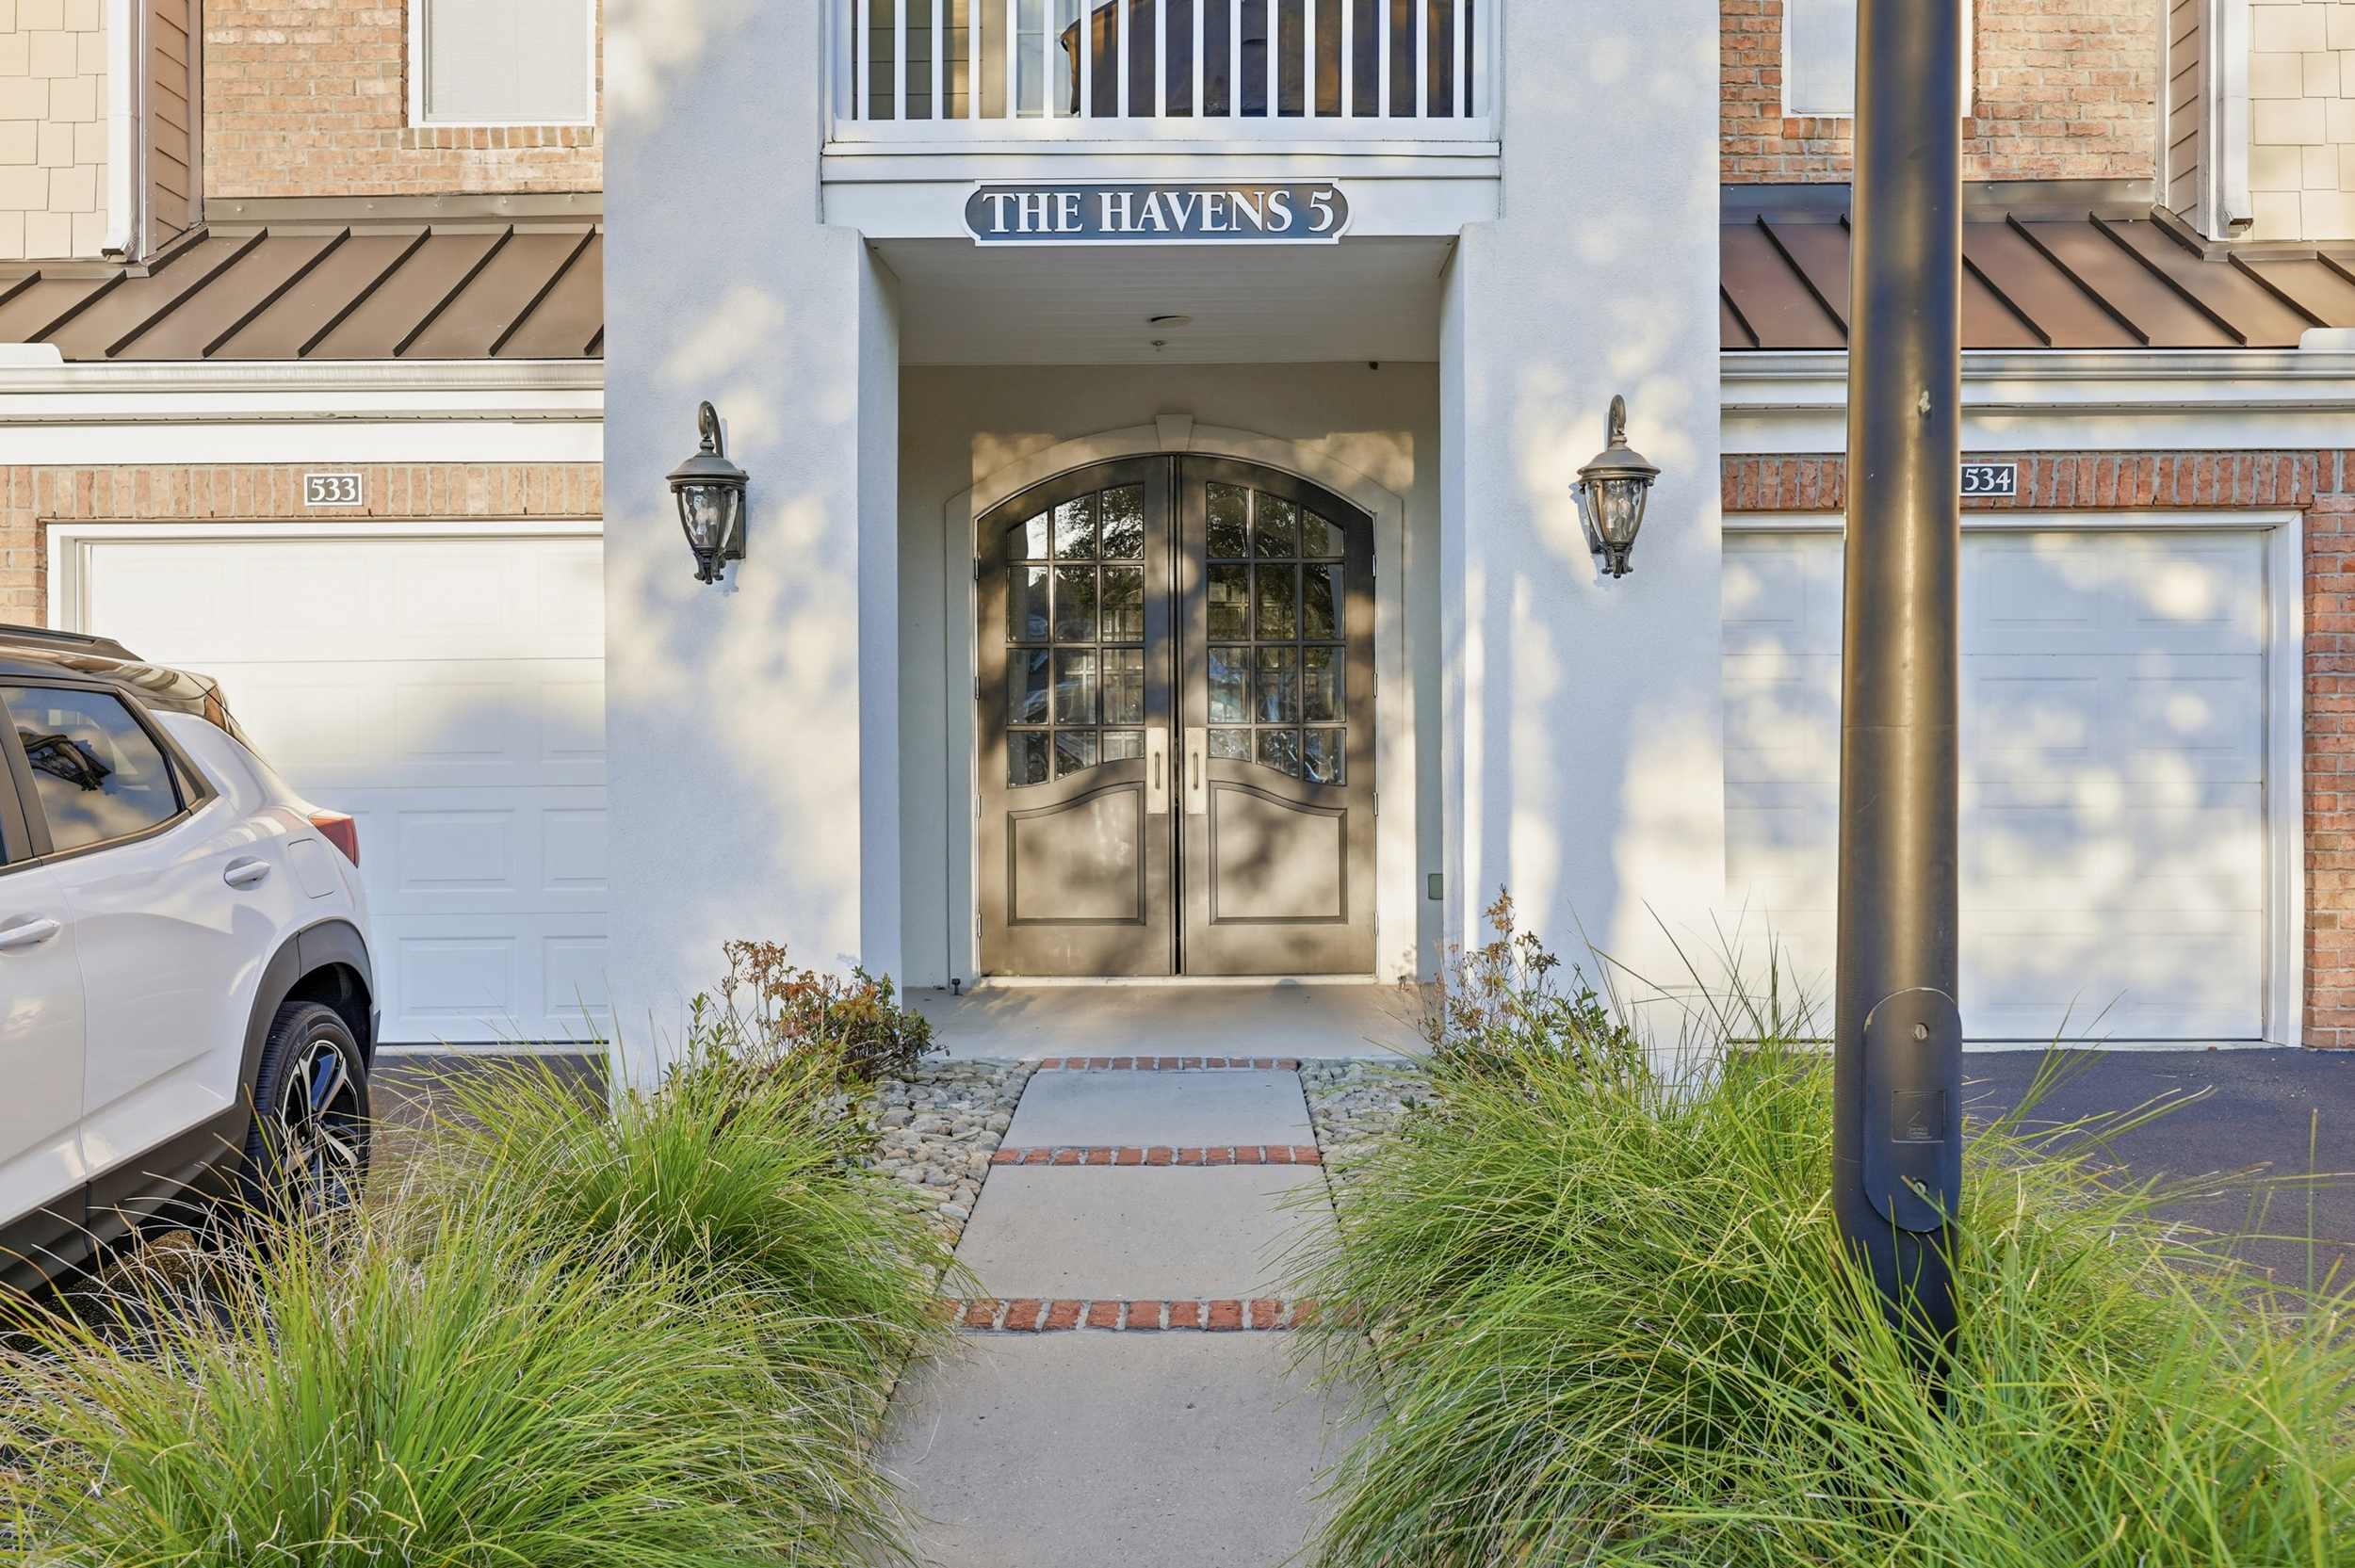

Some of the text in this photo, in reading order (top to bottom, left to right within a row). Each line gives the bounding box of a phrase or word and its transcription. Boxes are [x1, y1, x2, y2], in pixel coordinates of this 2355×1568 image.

[983, 189, 1334, 233] THE HAVENS 5
[310, 477, 356, 501] 533
[1964, 467, 2011, 492] 534
